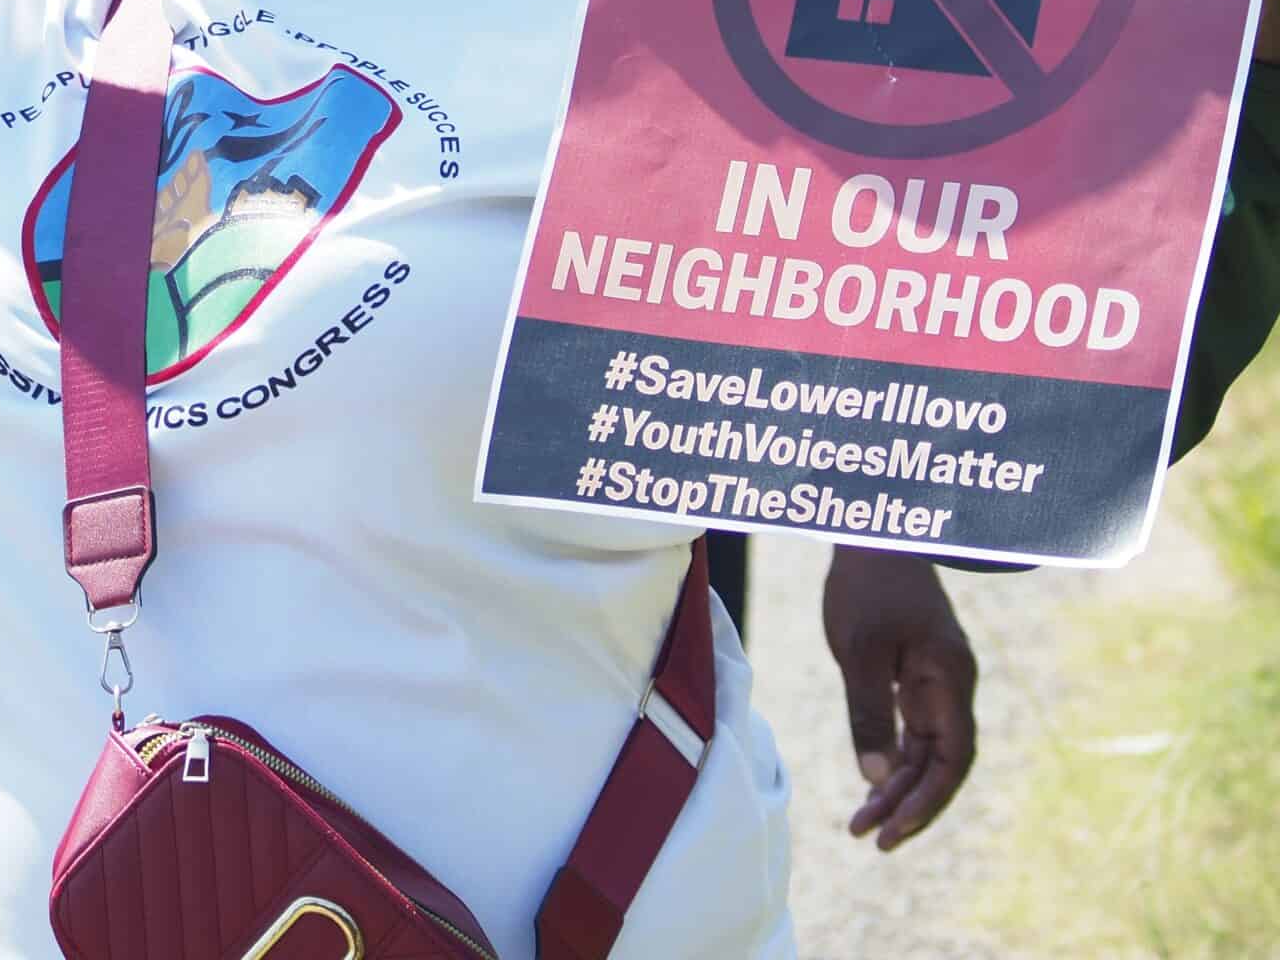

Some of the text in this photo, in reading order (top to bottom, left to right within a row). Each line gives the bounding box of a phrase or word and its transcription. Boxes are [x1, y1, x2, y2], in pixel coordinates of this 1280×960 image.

[716, 160, 1019, 261] IN OUR
[552, 231, 1140, 351] NEIGHBORHOOD
[215, 260, 411, 419] CONGRESS
[604, 351, 1007, 434] #SaveLowerIllovo
[587, 404, 1045, 494] #YouthVoicesMatter
[576, 457, 953, 539] #StopTheShelter
